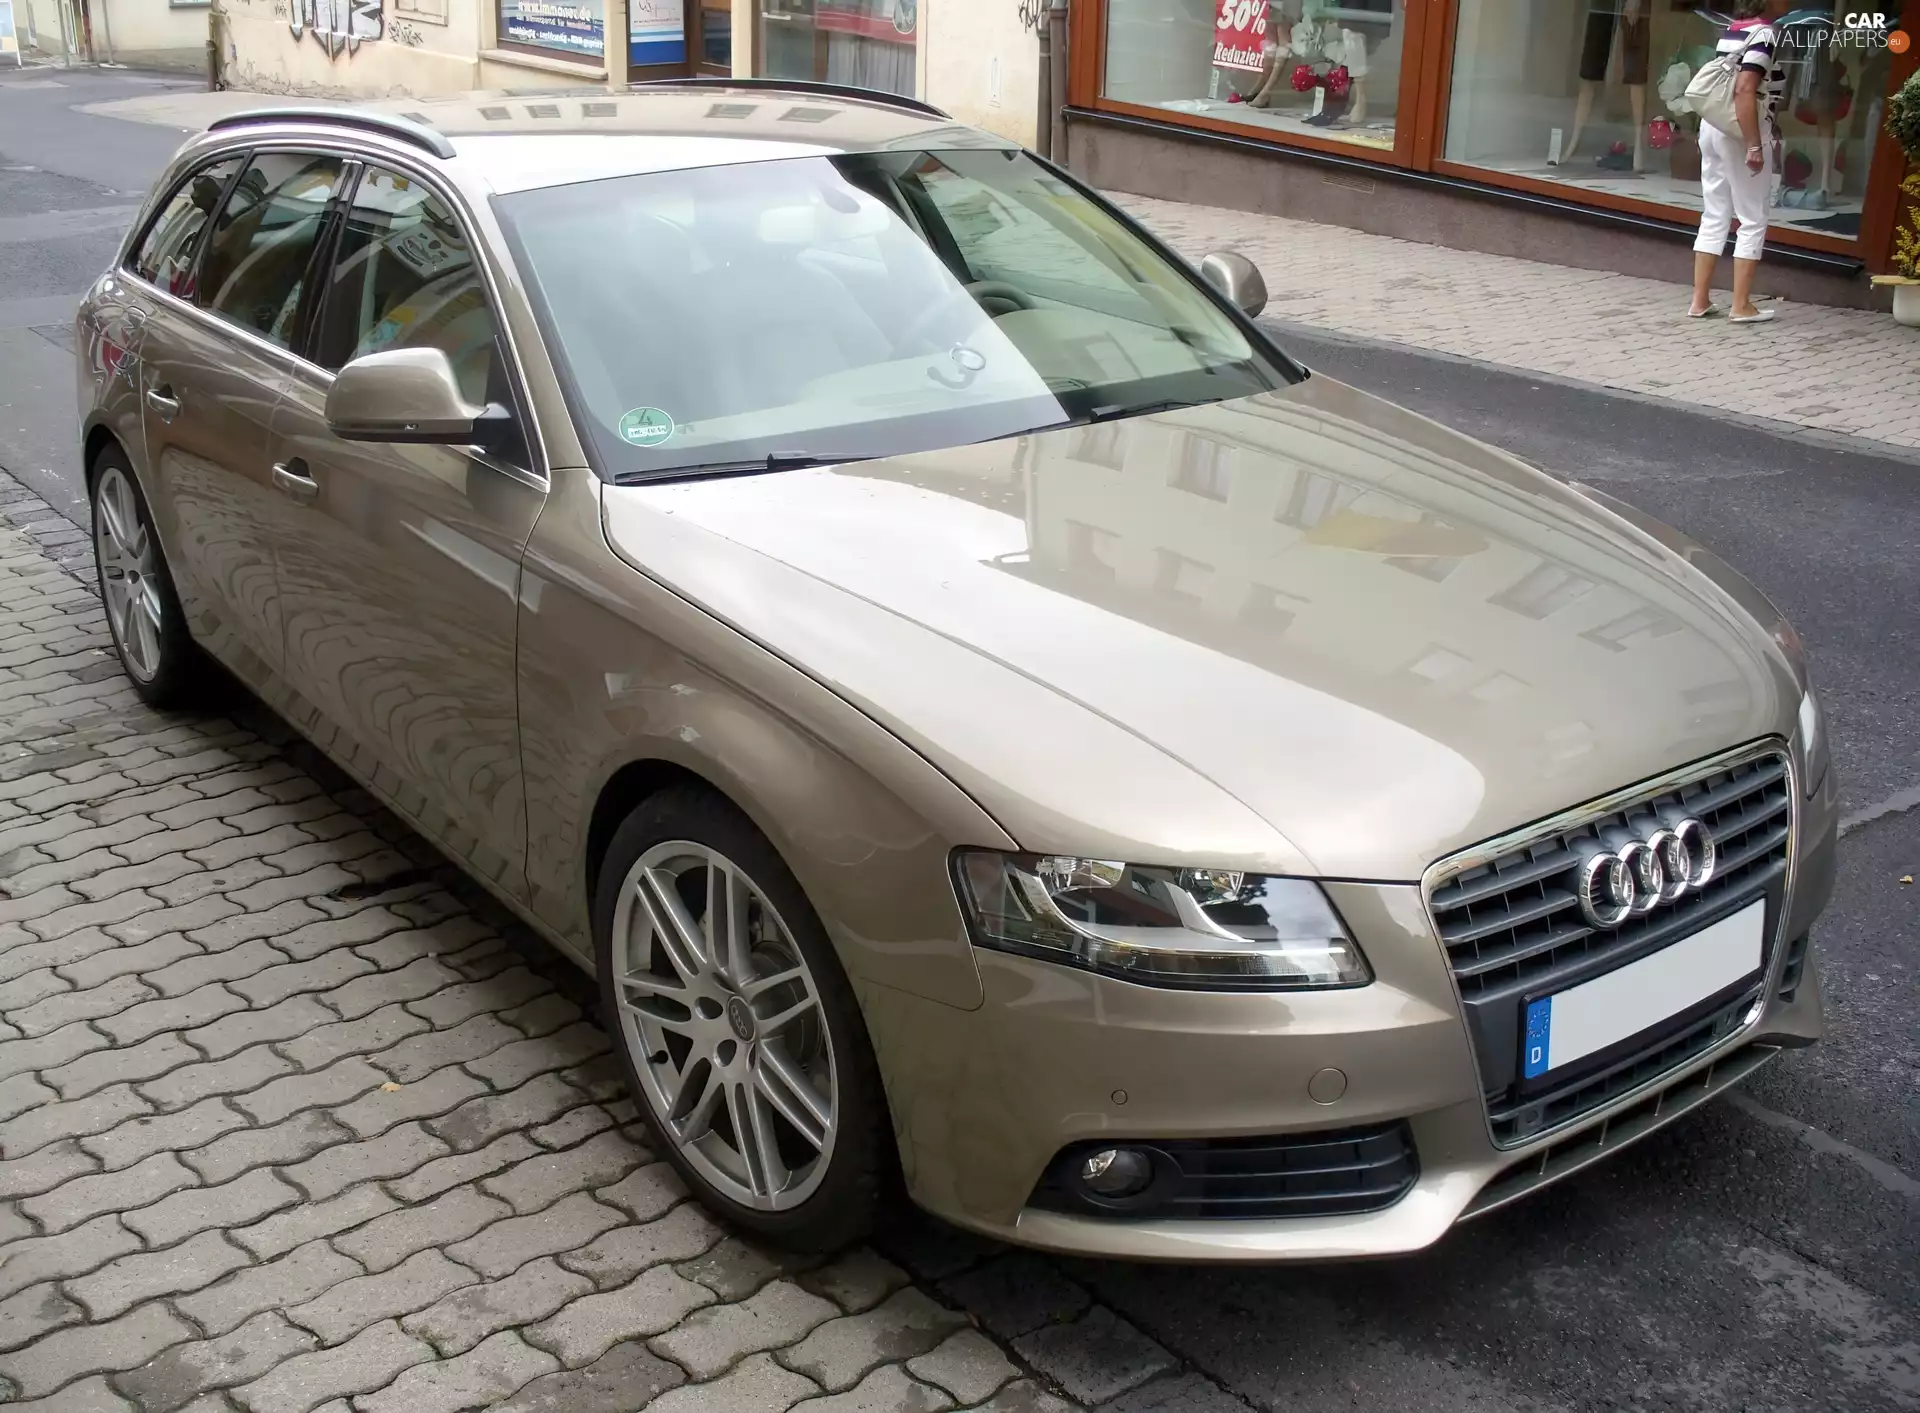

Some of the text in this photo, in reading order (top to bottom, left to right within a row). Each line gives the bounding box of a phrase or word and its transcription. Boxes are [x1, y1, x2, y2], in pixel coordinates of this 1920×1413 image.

[1216, 0, 1267, 35] 50%
[1213, 41, 1265, 67] Reduziert
[1531, 1046, 1541, 1064] D
